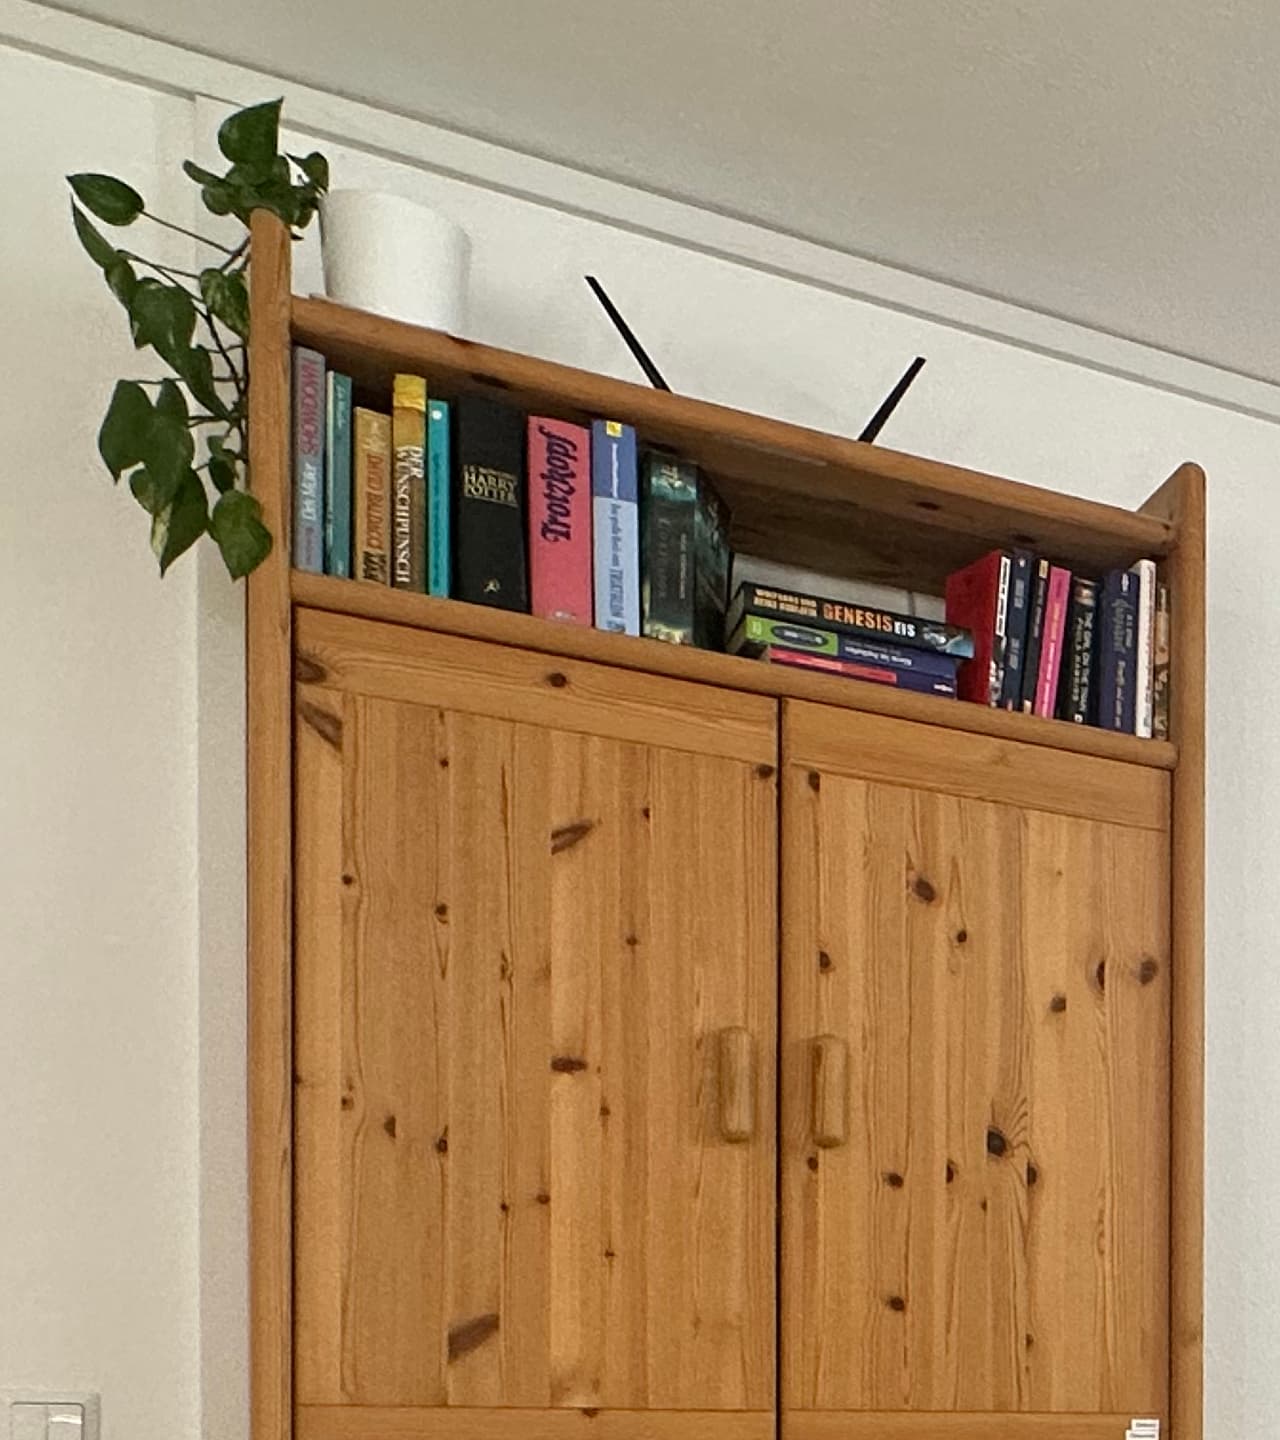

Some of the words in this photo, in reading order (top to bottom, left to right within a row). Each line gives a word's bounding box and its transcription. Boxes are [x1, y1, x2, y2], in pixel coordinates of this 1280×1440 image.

[409, 446, 424, 478] DER
[464, 472, 514, 491] HARRY
[464, 484, 518, 503] POTTER
[538, 424, 578, 543] Trotzkopf
[396, 447, 411, 583] WUNSCHPUNSCH
[823, 603, 892, 633] GENESIS
[894, 621, 916, 638] EIS
